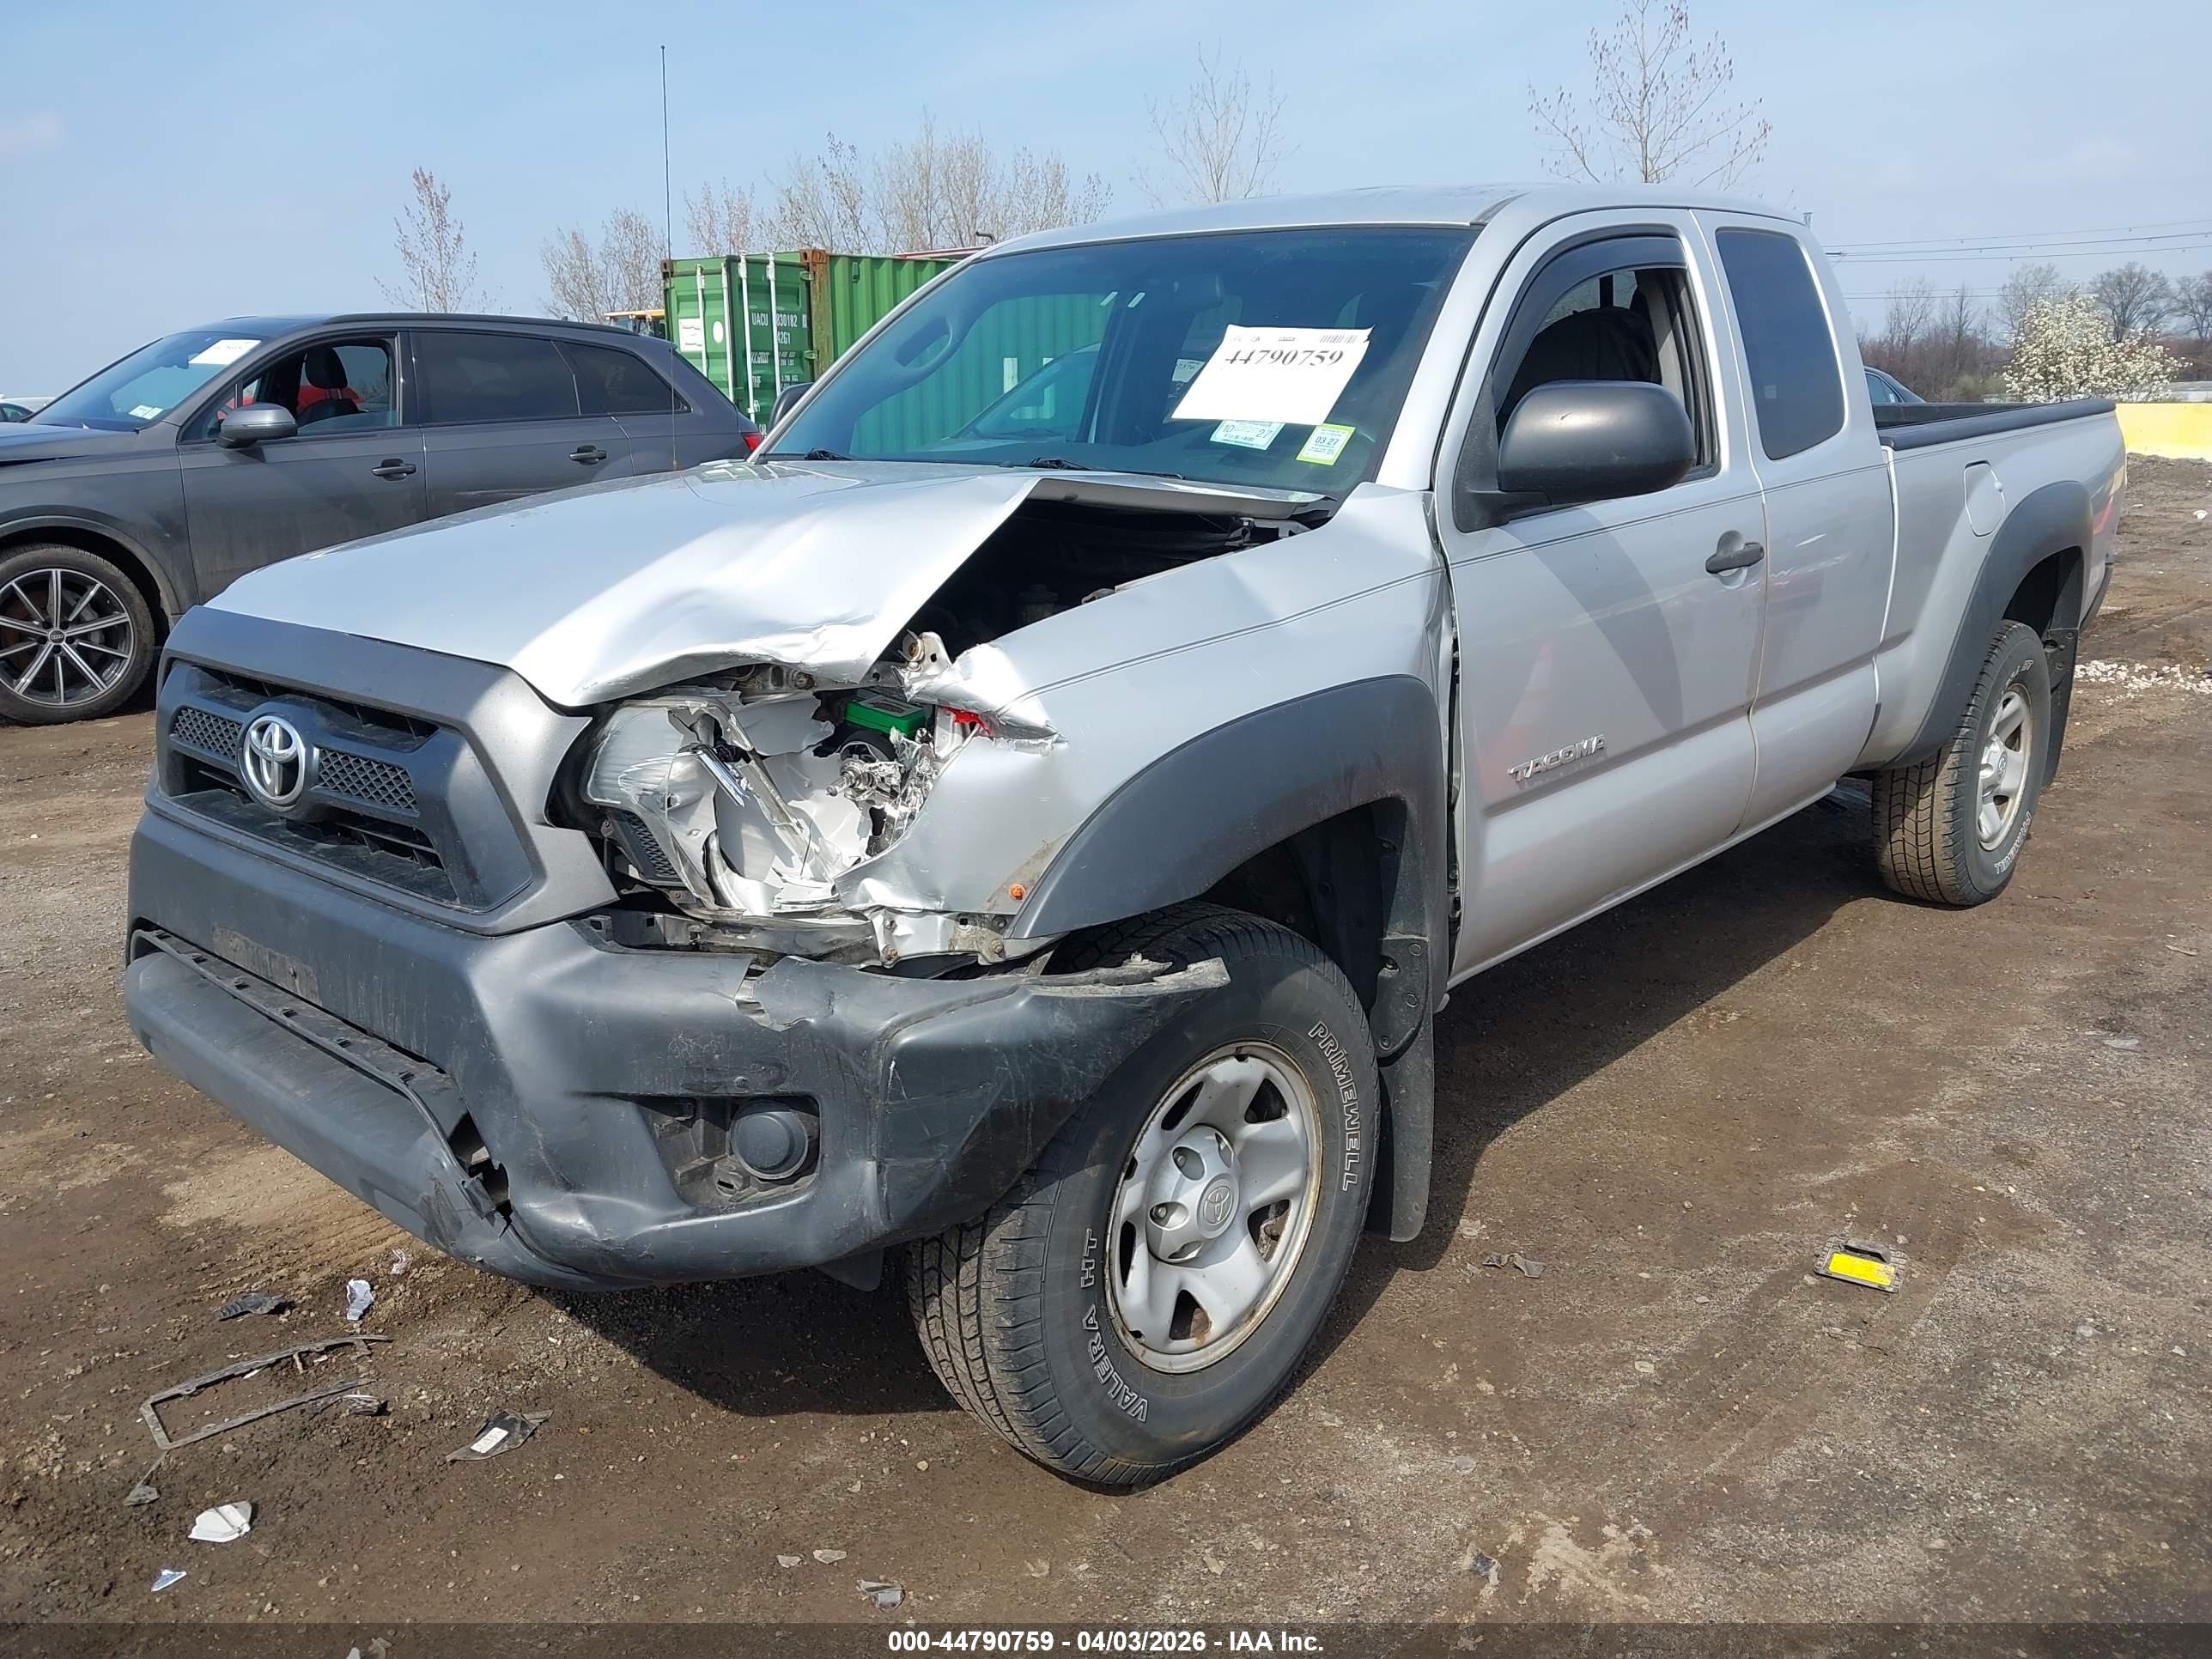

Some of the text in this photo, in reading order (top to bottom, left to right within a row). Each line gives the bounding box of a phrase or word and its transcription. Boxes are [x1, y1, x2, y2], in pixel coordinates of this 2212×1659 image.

[751, 312, 769, 326] UACU
[1224, 349, 1344, 366] 44790759
[1255, 428, 1273, 439] 27
[1507, 733, 1607, 782] TACOMA
[1080, 1227, 1148, 1423] VALERA HT
